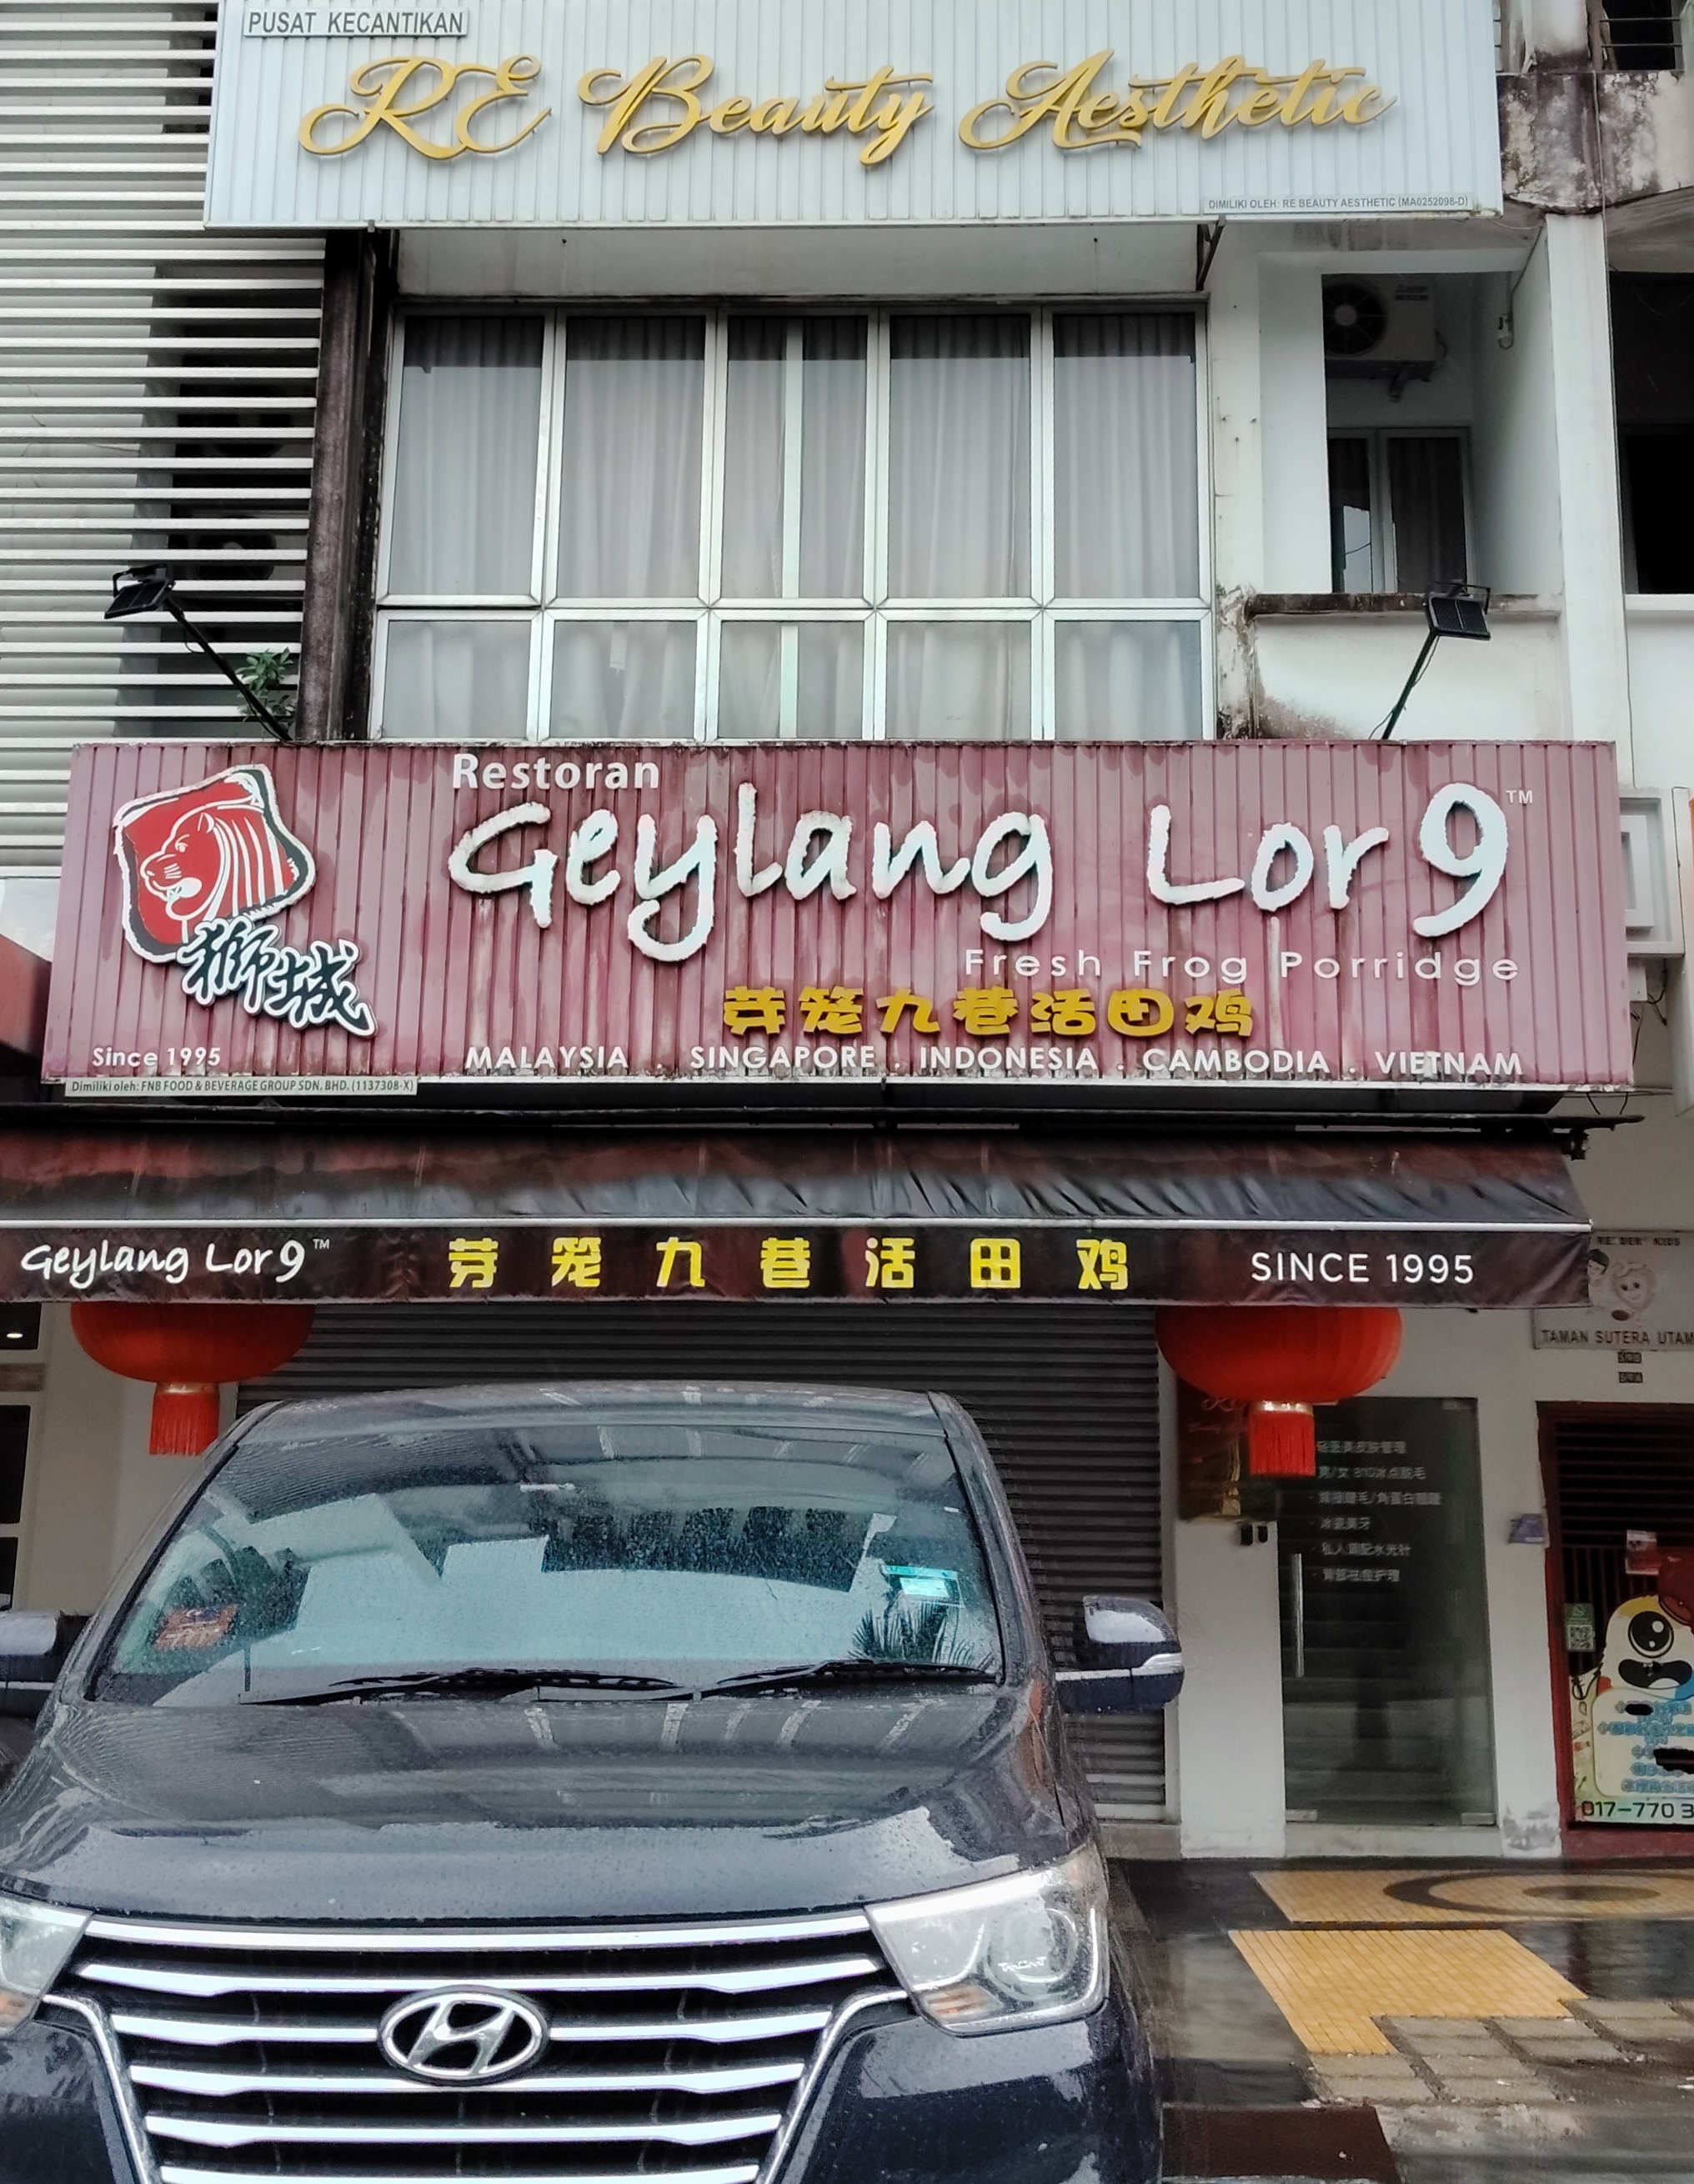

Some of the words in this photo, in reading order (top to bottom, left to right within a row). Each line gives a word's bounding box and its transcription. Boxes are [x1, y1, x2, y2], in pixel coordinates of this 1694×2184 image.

[248, 12, 316, 35] PUSAT
[328, 12, 464, 35] KECANTIKAN
[298, 54, 552, 161] RE
[579, 53, 935, 165] Beauty
[959, 48, 1398, 151] Aesthetic
[1208, 199, 1247, 209] DIMILIKI
[1250, 199, 1280, 208] OLEH:
[1282, 199, 1296, 208] RE
[1299, 198, 1337, 208] BEAUTY
[1340, 198, 1396, 208] AESTHETIC
[451, 754, 660, 789] Restoran
[448, 782, 1053, 962] Geylang
[1146, 804, 1390, 912] Lor
[1413, 782, 1509, 938] 9
[965, 949, 1101, 978] Fresh
[1134, 949, 1248, 984] Frog
[1280, 950, 1520, 987] Porridge
[723, 985, 1254, 1039] 芽笼九巷活田鸡
[92, 1047, 158, 1067] Since
[167, 1047, 222, 1067] 1995
[464, 1046, 629, 1069] MALAYSIA
[689, 1045, 875, 1069] SINGAPORE
[920, 1046, 1099, 1071] INDONESIA
[1143, 1049, 1331, 1074] CAMBODIA
[1375, 1050, 1524, 1076] VIETNAM
[72, 1081, 112, 1092] Dimiliki
[113, 1080, 139, 1092] oleh:
[141, 1081, 162, 1092] FNB
[163, 1081, 193, 1092] FOOD
[195, 1081, 203, 1092] &
[204, 1080, 258, 1092] BEVERAGE
[260, 1080, 297, 1092] GROUP
[298, 1080, 323, 1092] SDN.
[325, 1080, 349, 1092] BHD.
[351, 1080, 414, 1093] (1137308-X)
[21, 1240, 190, 1287] Geylang
[448, 1237, 1129, 1290] 芽笼九巷活田鸡
[1251, 1252, 1370, 1283] SINCE
[1386, 1254, 1475, 1284] 1995
[1541, 1330, 1589, 1344] TAMAN
[1596, 1330, 1650, 1345] SUTERA
[1582, 1801, 1674, 1818] 017-770
